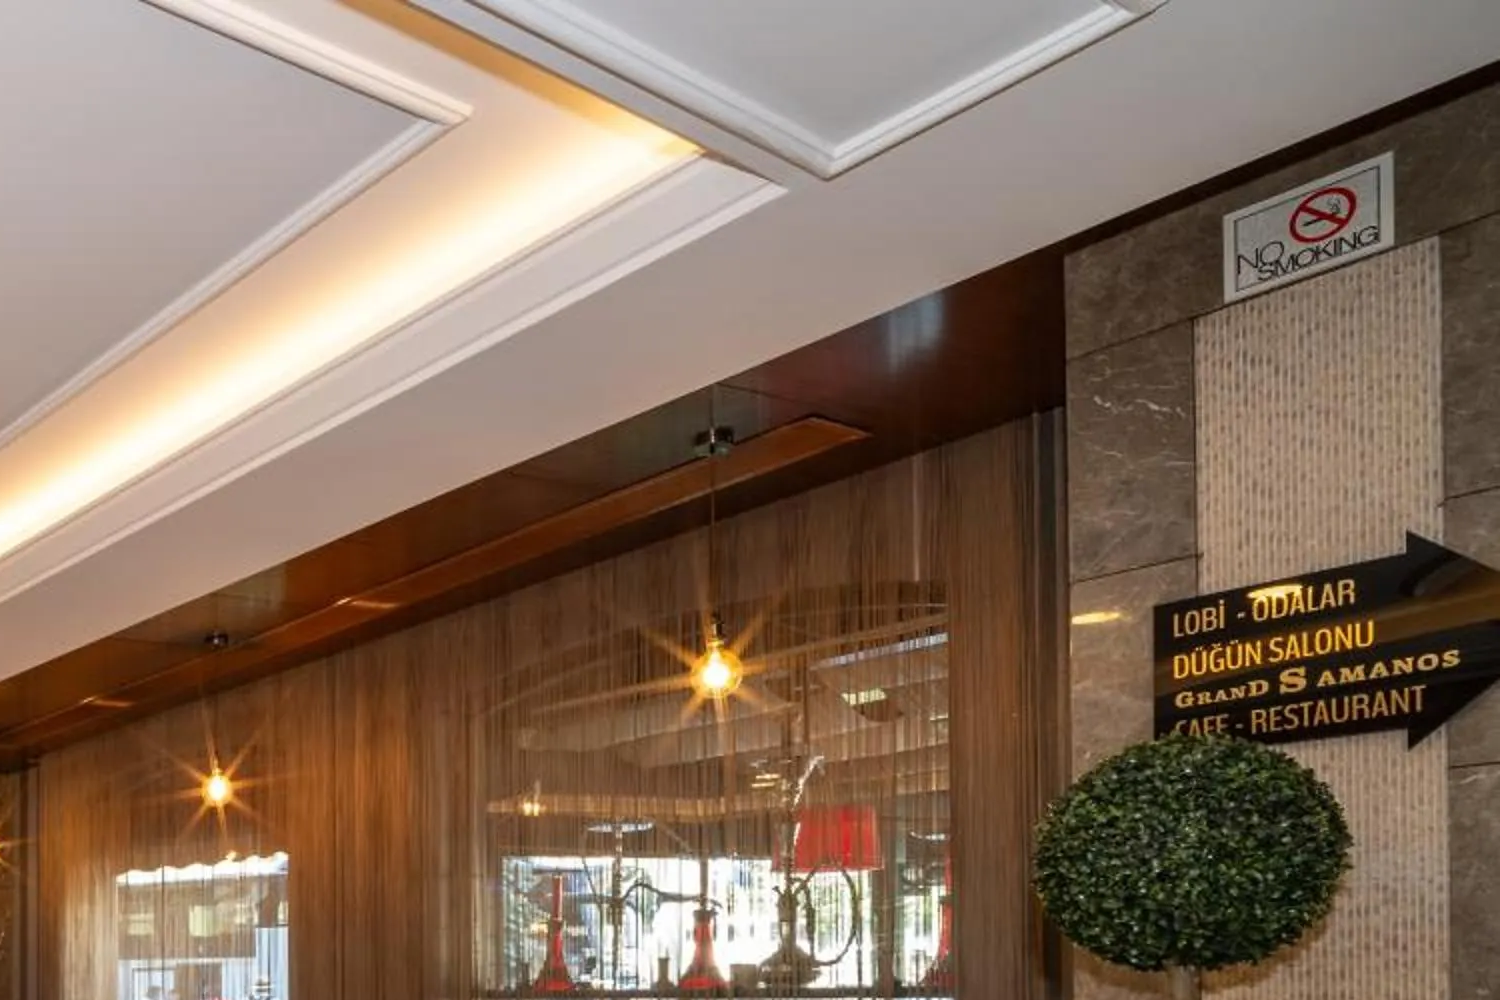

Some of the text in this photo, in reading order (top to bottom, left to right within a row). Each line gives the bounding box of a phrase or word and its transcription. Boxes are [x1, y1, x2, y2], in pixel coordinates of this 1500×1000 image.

[1237, 241, 1285, 275] NO
[1258, 225, 1380, 281] SMOKING
[1173, 600, 1225, 638] LOBİ
[1252, 579, 1356, 622] ODALAR
[1173, 619, 1375, 680] DÜĞÜN SALONU
[1175, 678, 1270, 708] GRAND
[1251, 684, 1427, 735] RESTAURANT
